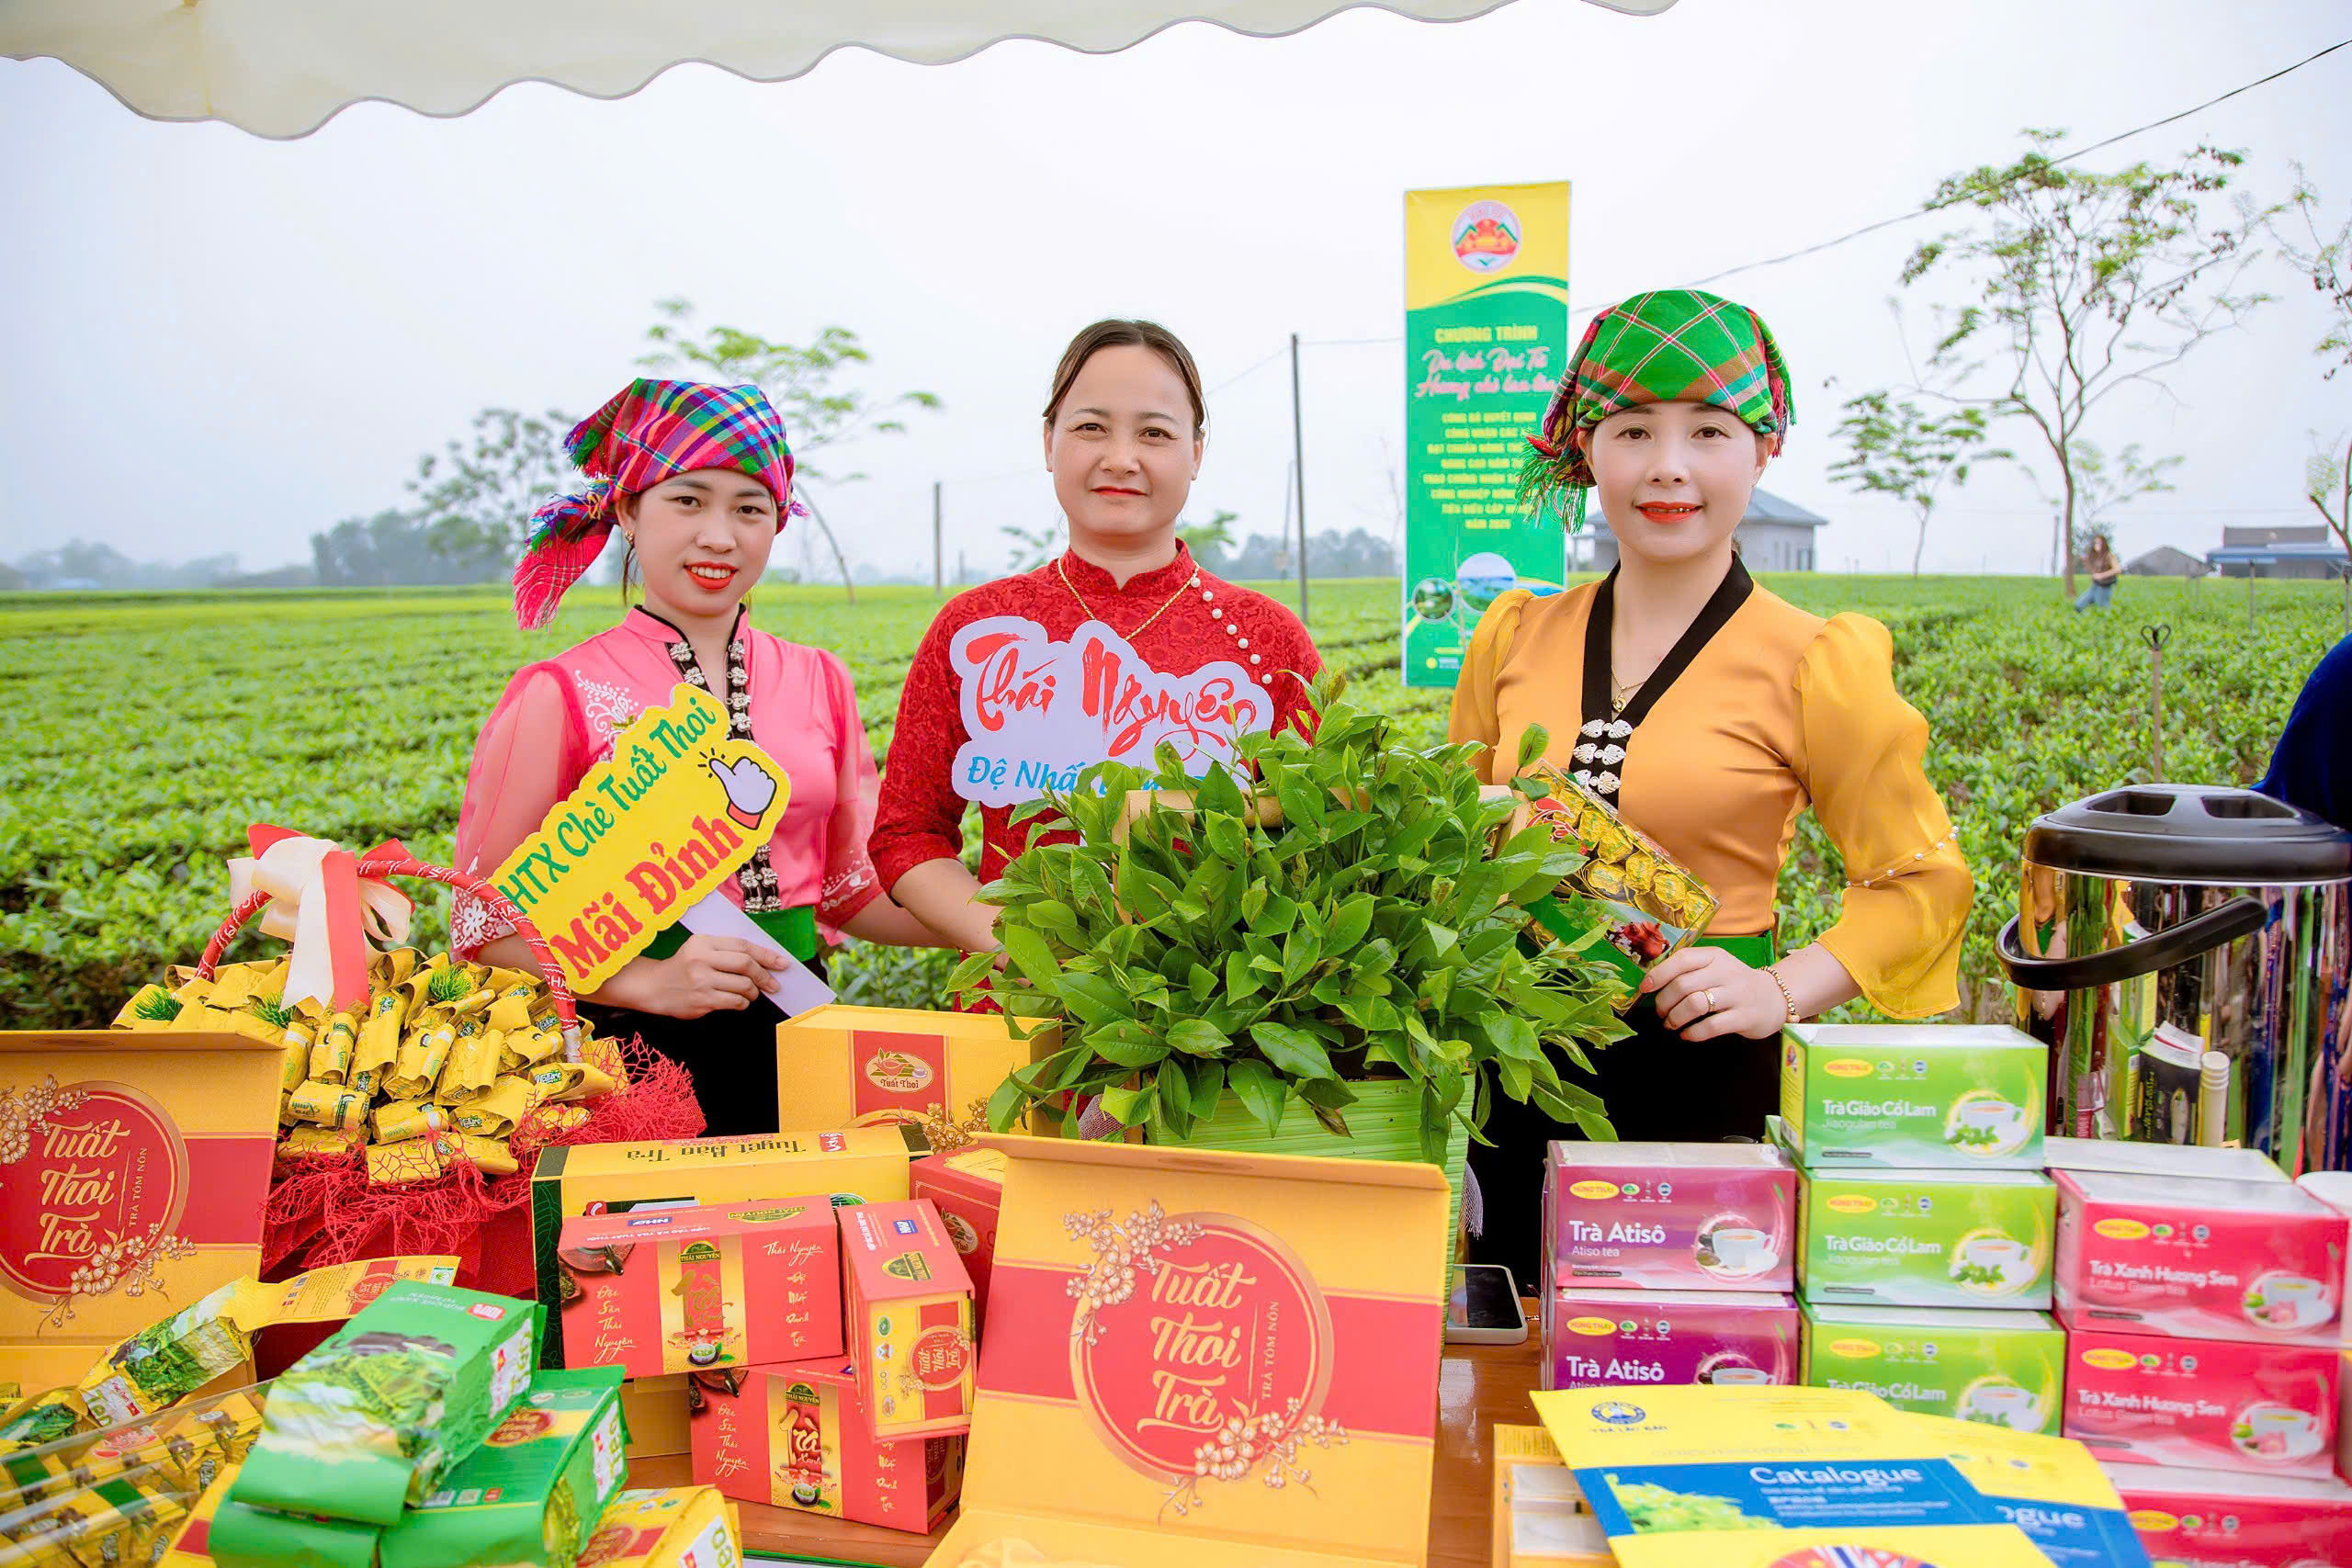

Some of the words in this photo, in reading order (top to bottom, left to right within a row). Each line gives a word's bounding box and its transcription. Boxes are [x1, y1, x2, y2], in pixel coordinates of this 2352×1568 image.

[966, 632, 1058, 731] Thái
[1081, 637, 1258, 762] Nguyên
[967, 756, 1008, 787] Đệ
[1015, 760, 1088, 793] Nhấ
[498, 842, 570, 915] HTX
[558, 801, 615, 857] Chè
[597, 744, 668, 812] Tuất
[550, 891, 643, 979] Mãi
[625, 815, 744, 915] Đỉnh
[1823, 1100, 1845, 1115] Trà
[1905, 1101, 1937, 1117] Lam
[42, 1119, 130, 1159] Tuất
[25, 1210, 102, 1266] Trà
[1569, 1220, 1604, 1243] Trà
[1606, 1221, 1667, 1244] Atisô
[1825, 1235, 1848, 1250] Trà
[1909, 1237, 1941, 1254] Lam
[1572, 1246, 1600, 1257] Atiso
[1601, 1247, 1620, 1258] tea
[1150, 1261, 1258, 1310] Tuất
[1566, 1356, 1601, 1379] Trà
[1604, 1358, 1666, 1382] Atisô
[1136, 1369, 1227, 1433] Trà
[1913, 1385, 1948, 1402] Lam
[1749, 1466, 1925, 1488] Catalogue
